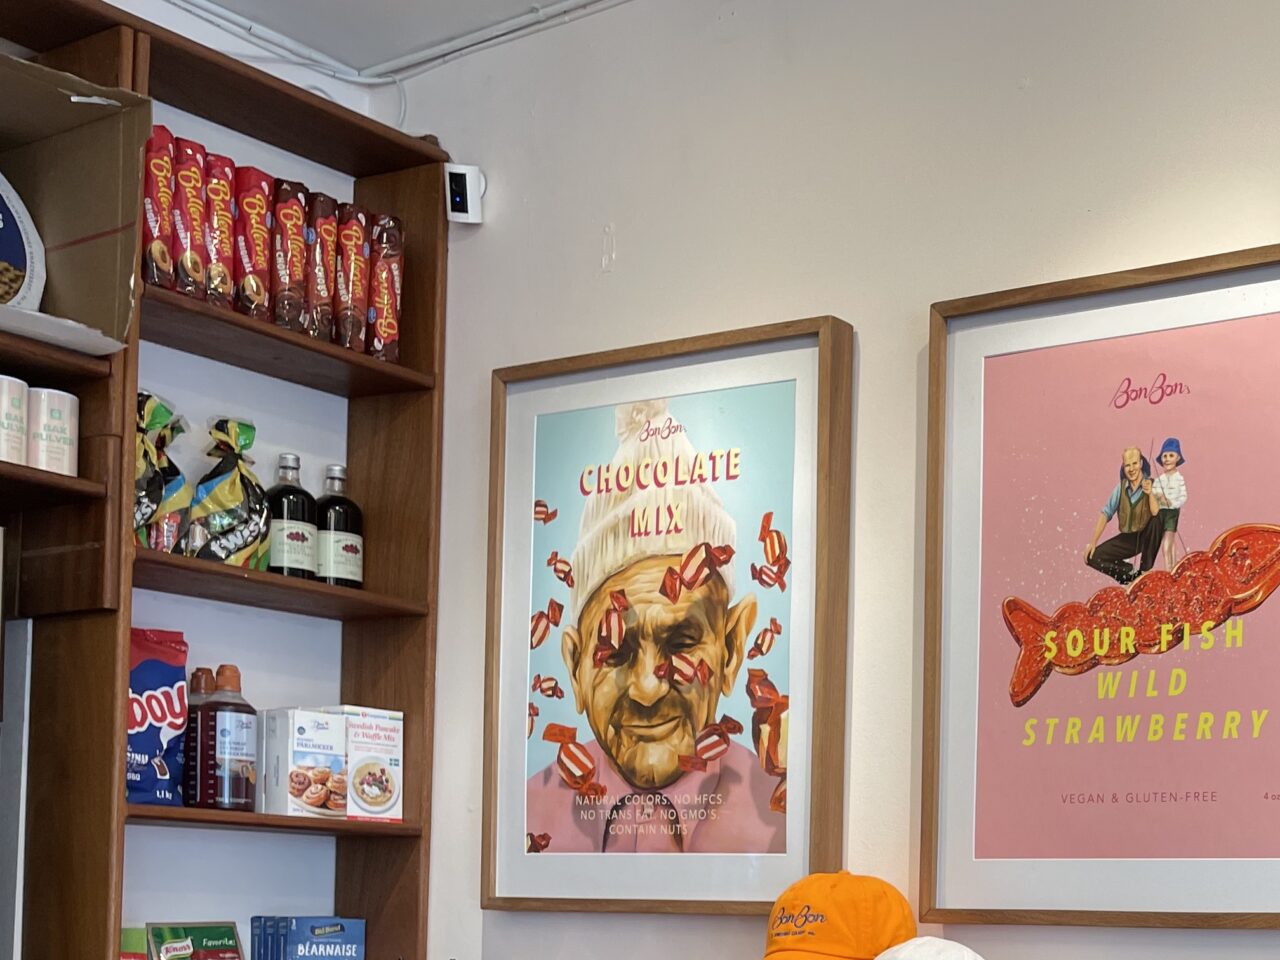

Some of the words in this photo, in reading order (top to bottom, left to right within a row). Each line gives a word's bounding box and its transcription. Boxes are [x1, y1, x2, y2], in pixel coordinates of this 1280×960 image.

[243, 194, 267, 268] Ballerina
[580, 448, 741, 496] CHOCOLATE
[629, 504, 684, 538] MIX
[1044, 626, 1136, 659] SOUR
[1160, 619, 1243, 651] FISH
[1097, 668, 1187, 699] WILD
[1022, 709, 1268, 746] STRAWBERRY
[575, 794, 622, 806] NATURAL
[624, 794, 670, 806] COLORS.
[674, 794, 691, 804] NO
[694, 793, 725, 804] HFCS.
[1061, 793, 1105, 804] VEGAN
[1111, 792, 1119, 803] &
[1125, 791, 1217, 804] GLUTEN-FREE
[580, 810, 596, 820] NO
[600, 809, 631, 820] TRANS
[660, 809, 676, 819] NO
[609, 825, 656, 835] CONTAIN
[660, 824, 688, 835] NUTS
[298, 941, 357, 956] BÉARNAISE
